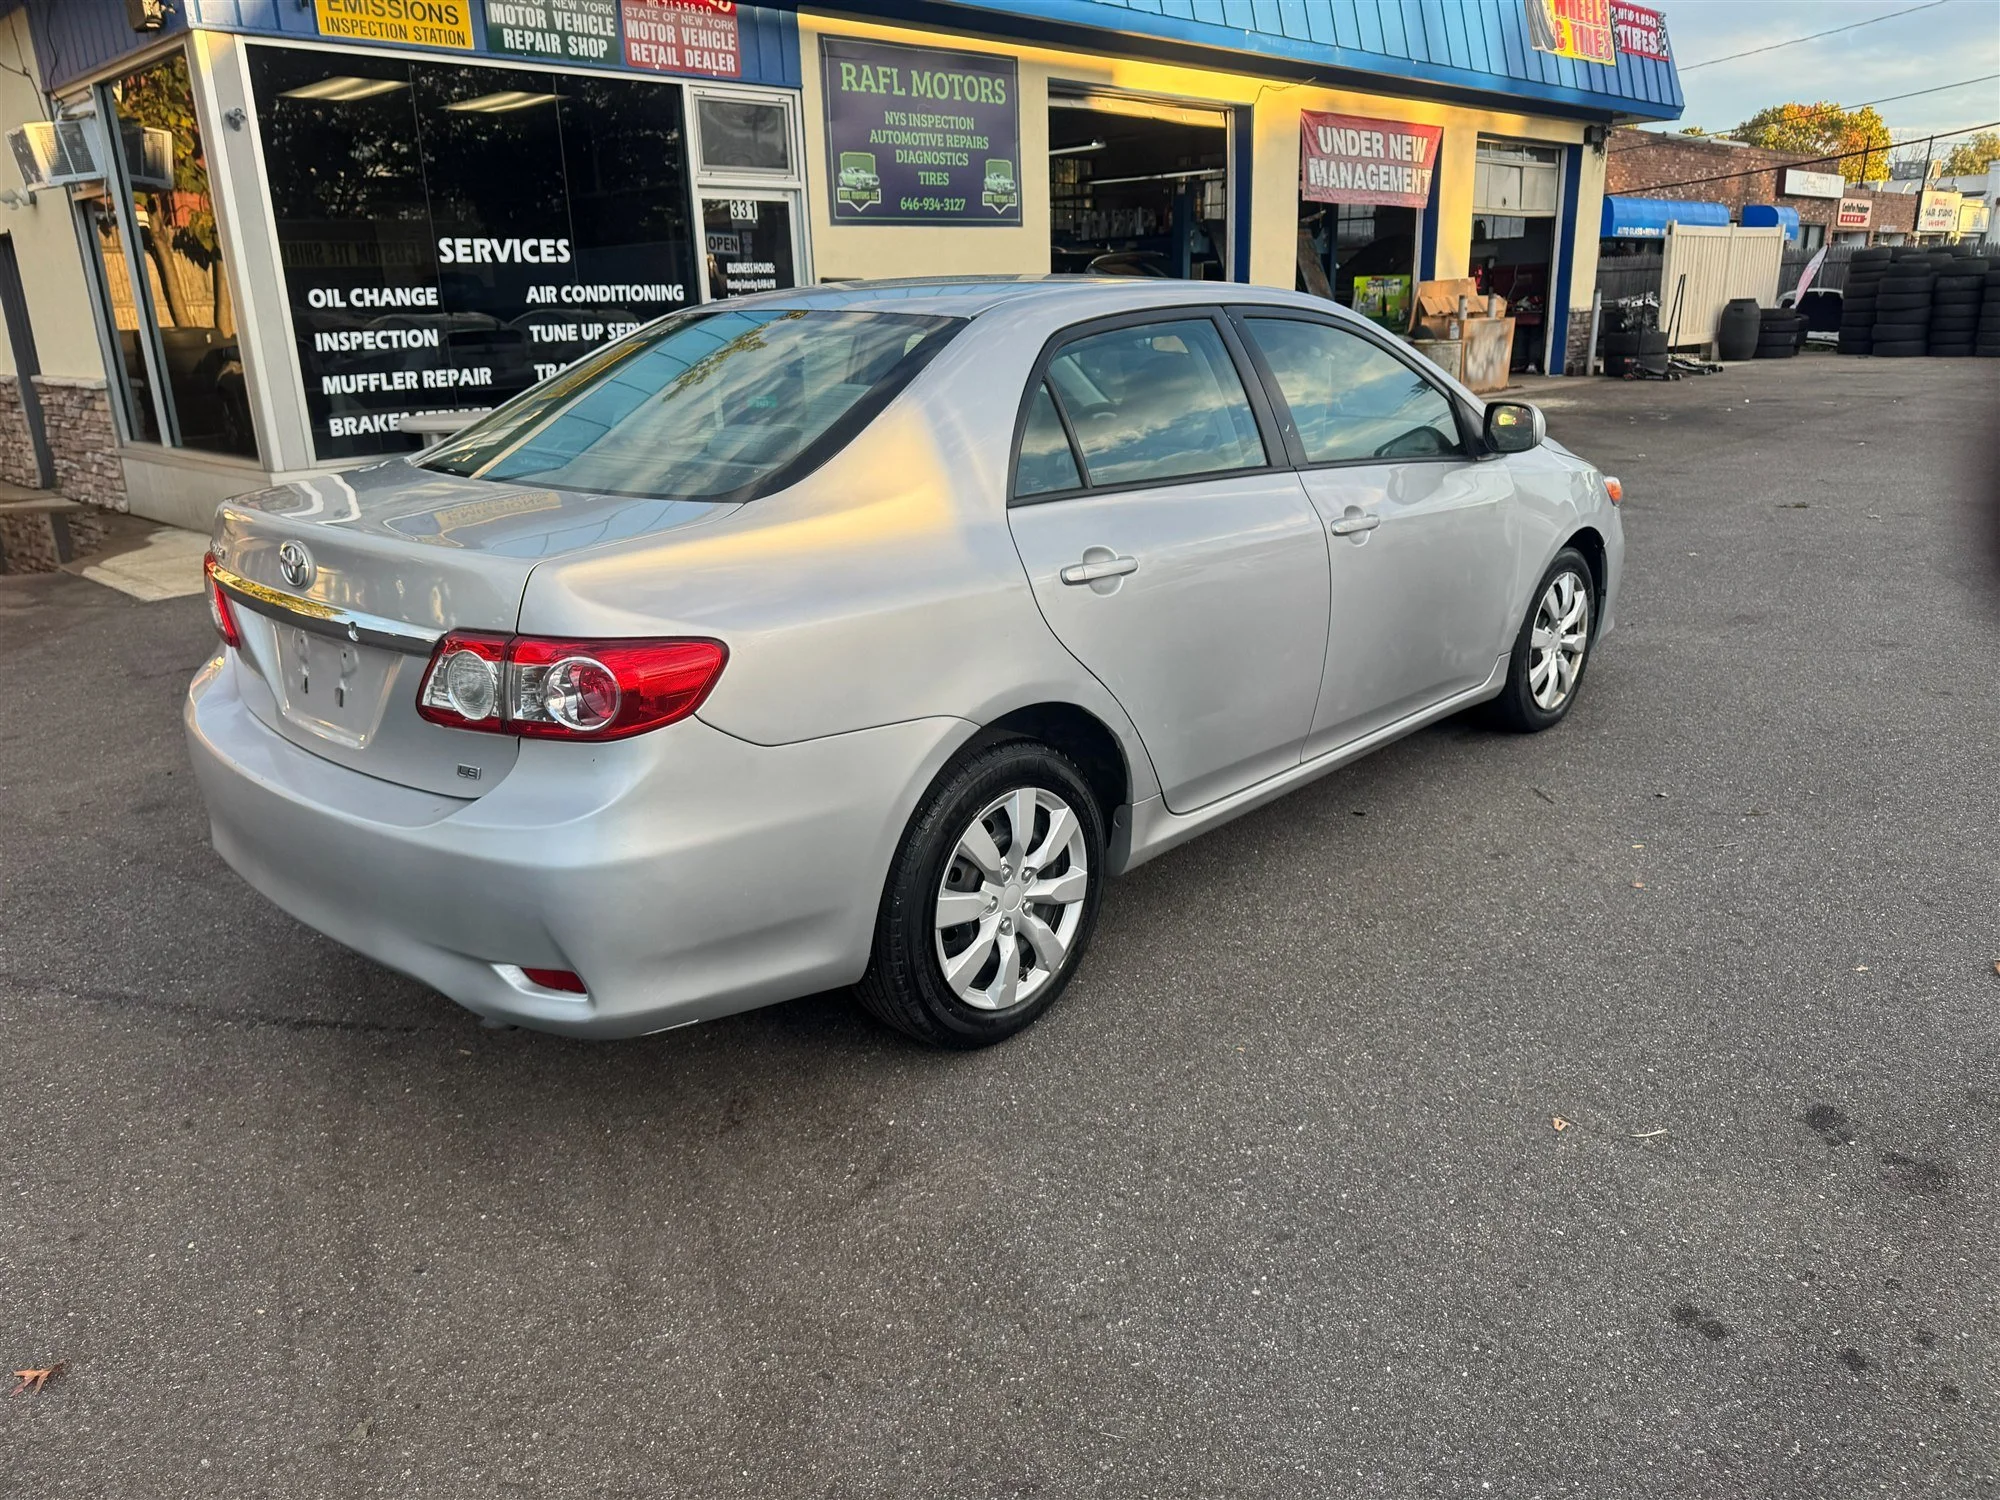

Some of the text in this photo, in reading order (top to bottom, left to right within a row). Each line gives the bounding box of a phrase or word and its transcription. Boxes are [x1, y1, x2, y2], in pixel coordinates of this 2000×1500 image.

[327, 0, 459, 25] EMISSIONS
[552, 0, 577, 10] NEW
[581, 1, 613, 15] YORK
[625, 7, 734, 31] STATE OF NEW YORK
[661, 0, 712, 16] 7135830
[326, 16, 465, 46] INSPECTION STATION
[490, 3, 616, 37] MOTOR VEHICLE
[502, 28, 608, 58] REPAIR SHOP
[625, 19, 736, 51] MOTOR VEHICLE
[1571, 22, 1613, 60] TIRES
[1618, 24, 1659, 55] TIRES
[630, 42, 735, 72] RETAIL DEALER
[840, 62, 1007, 105] RAFL MOTORS
[884, 111, 975, 131] NYS INSPECTION
[869, 129, 989, 150] AUTOMOTIVE REPAIRS
[1318, 126, 1428, 163] UNDER NEW
[895, 149, 969, 167] DIAGNOSTICS
[918, 171, 950, 186] TIRES
[1308, 158, 1432, 194] MANAGEMENT
[731, 200, 756, 219] 331
[900, 197, 966, 212] 646-934-3127
[439, 238, 571, 264] SERVICES
[708, 236, 739, 252] OPEN
[308, 287, 439, 309] OIL CHANGE
[526, 284, 685, 303] AIR CONDITIONING
[315, 329, 439, 352] INSPECTION
[529, 322, 643, 343] TUNE UP SER
[322, 367, 492, 395] MUFFLER REPAIR
[329, 412, 410, 437] BRAKE
